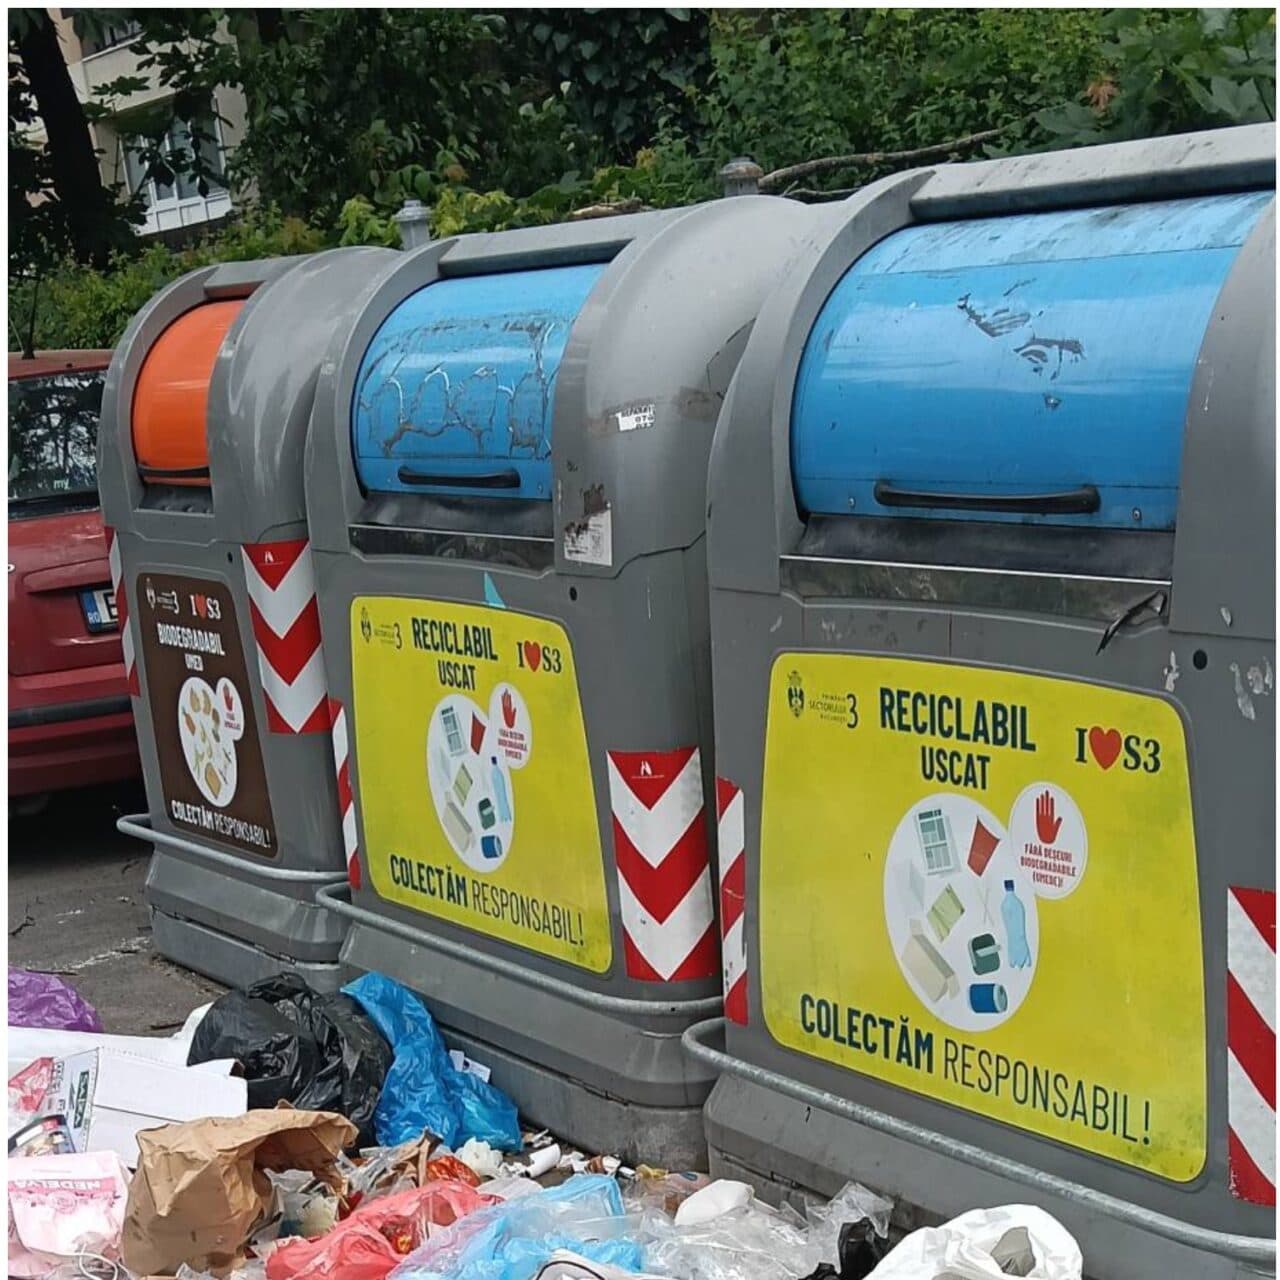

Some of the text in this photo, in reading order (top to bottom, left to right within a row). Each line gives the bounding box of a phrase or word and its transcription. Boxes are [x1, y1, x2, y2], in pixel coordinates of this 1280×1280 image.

[190, 594, 198, 616] I
[206, 597, 221, 619] S3
[156, 623, 226, 656] BIODEGRADABIL
[393, 622, 403, 650] 3
[411, 617, 499, 661] RECICLABIL
[517, 642, 562, 674] I S3
[438, 660, 476, 691] USCAT
[846, 693, 859, 729] 3
[879, 687, 1037, 753] RECICLABIL
[921, 746, 991, 790] USCAT
[1075, 727, 1161, 773] I S3
[171, 799, 272, 848] COLECTĂM RESPONSABIL!
[390, 853, 585, 946] COLECTĂM RESPONSABIL!
[800, 993, 1151, 1145] COLECTĂM RESPONSABIL!
